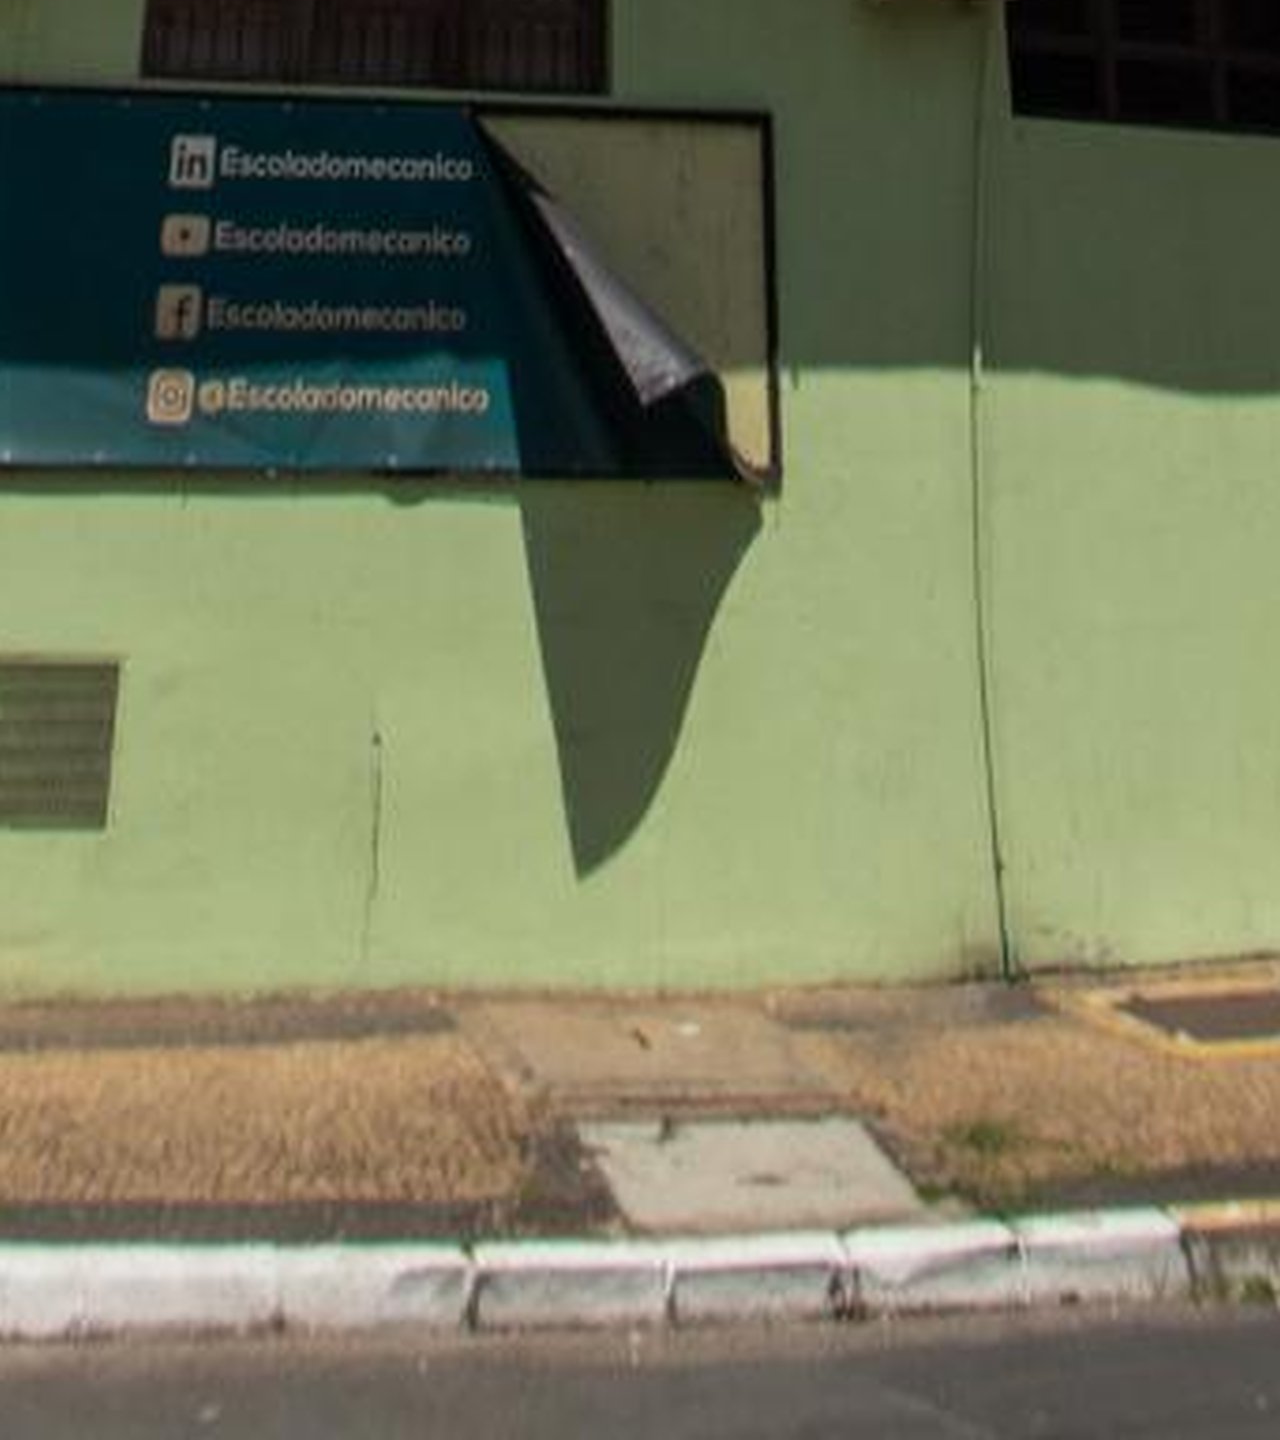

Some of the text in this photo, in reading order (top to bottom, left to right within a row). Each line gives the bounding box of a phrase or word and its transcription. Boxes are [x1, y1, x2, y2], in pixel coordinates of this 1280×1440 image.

[221, 146, 473, 181] Escoladomecanico
[215, 221, 470, 255] Escoladomecanico
[207, 297, 466, 330] Escoladomecanico
